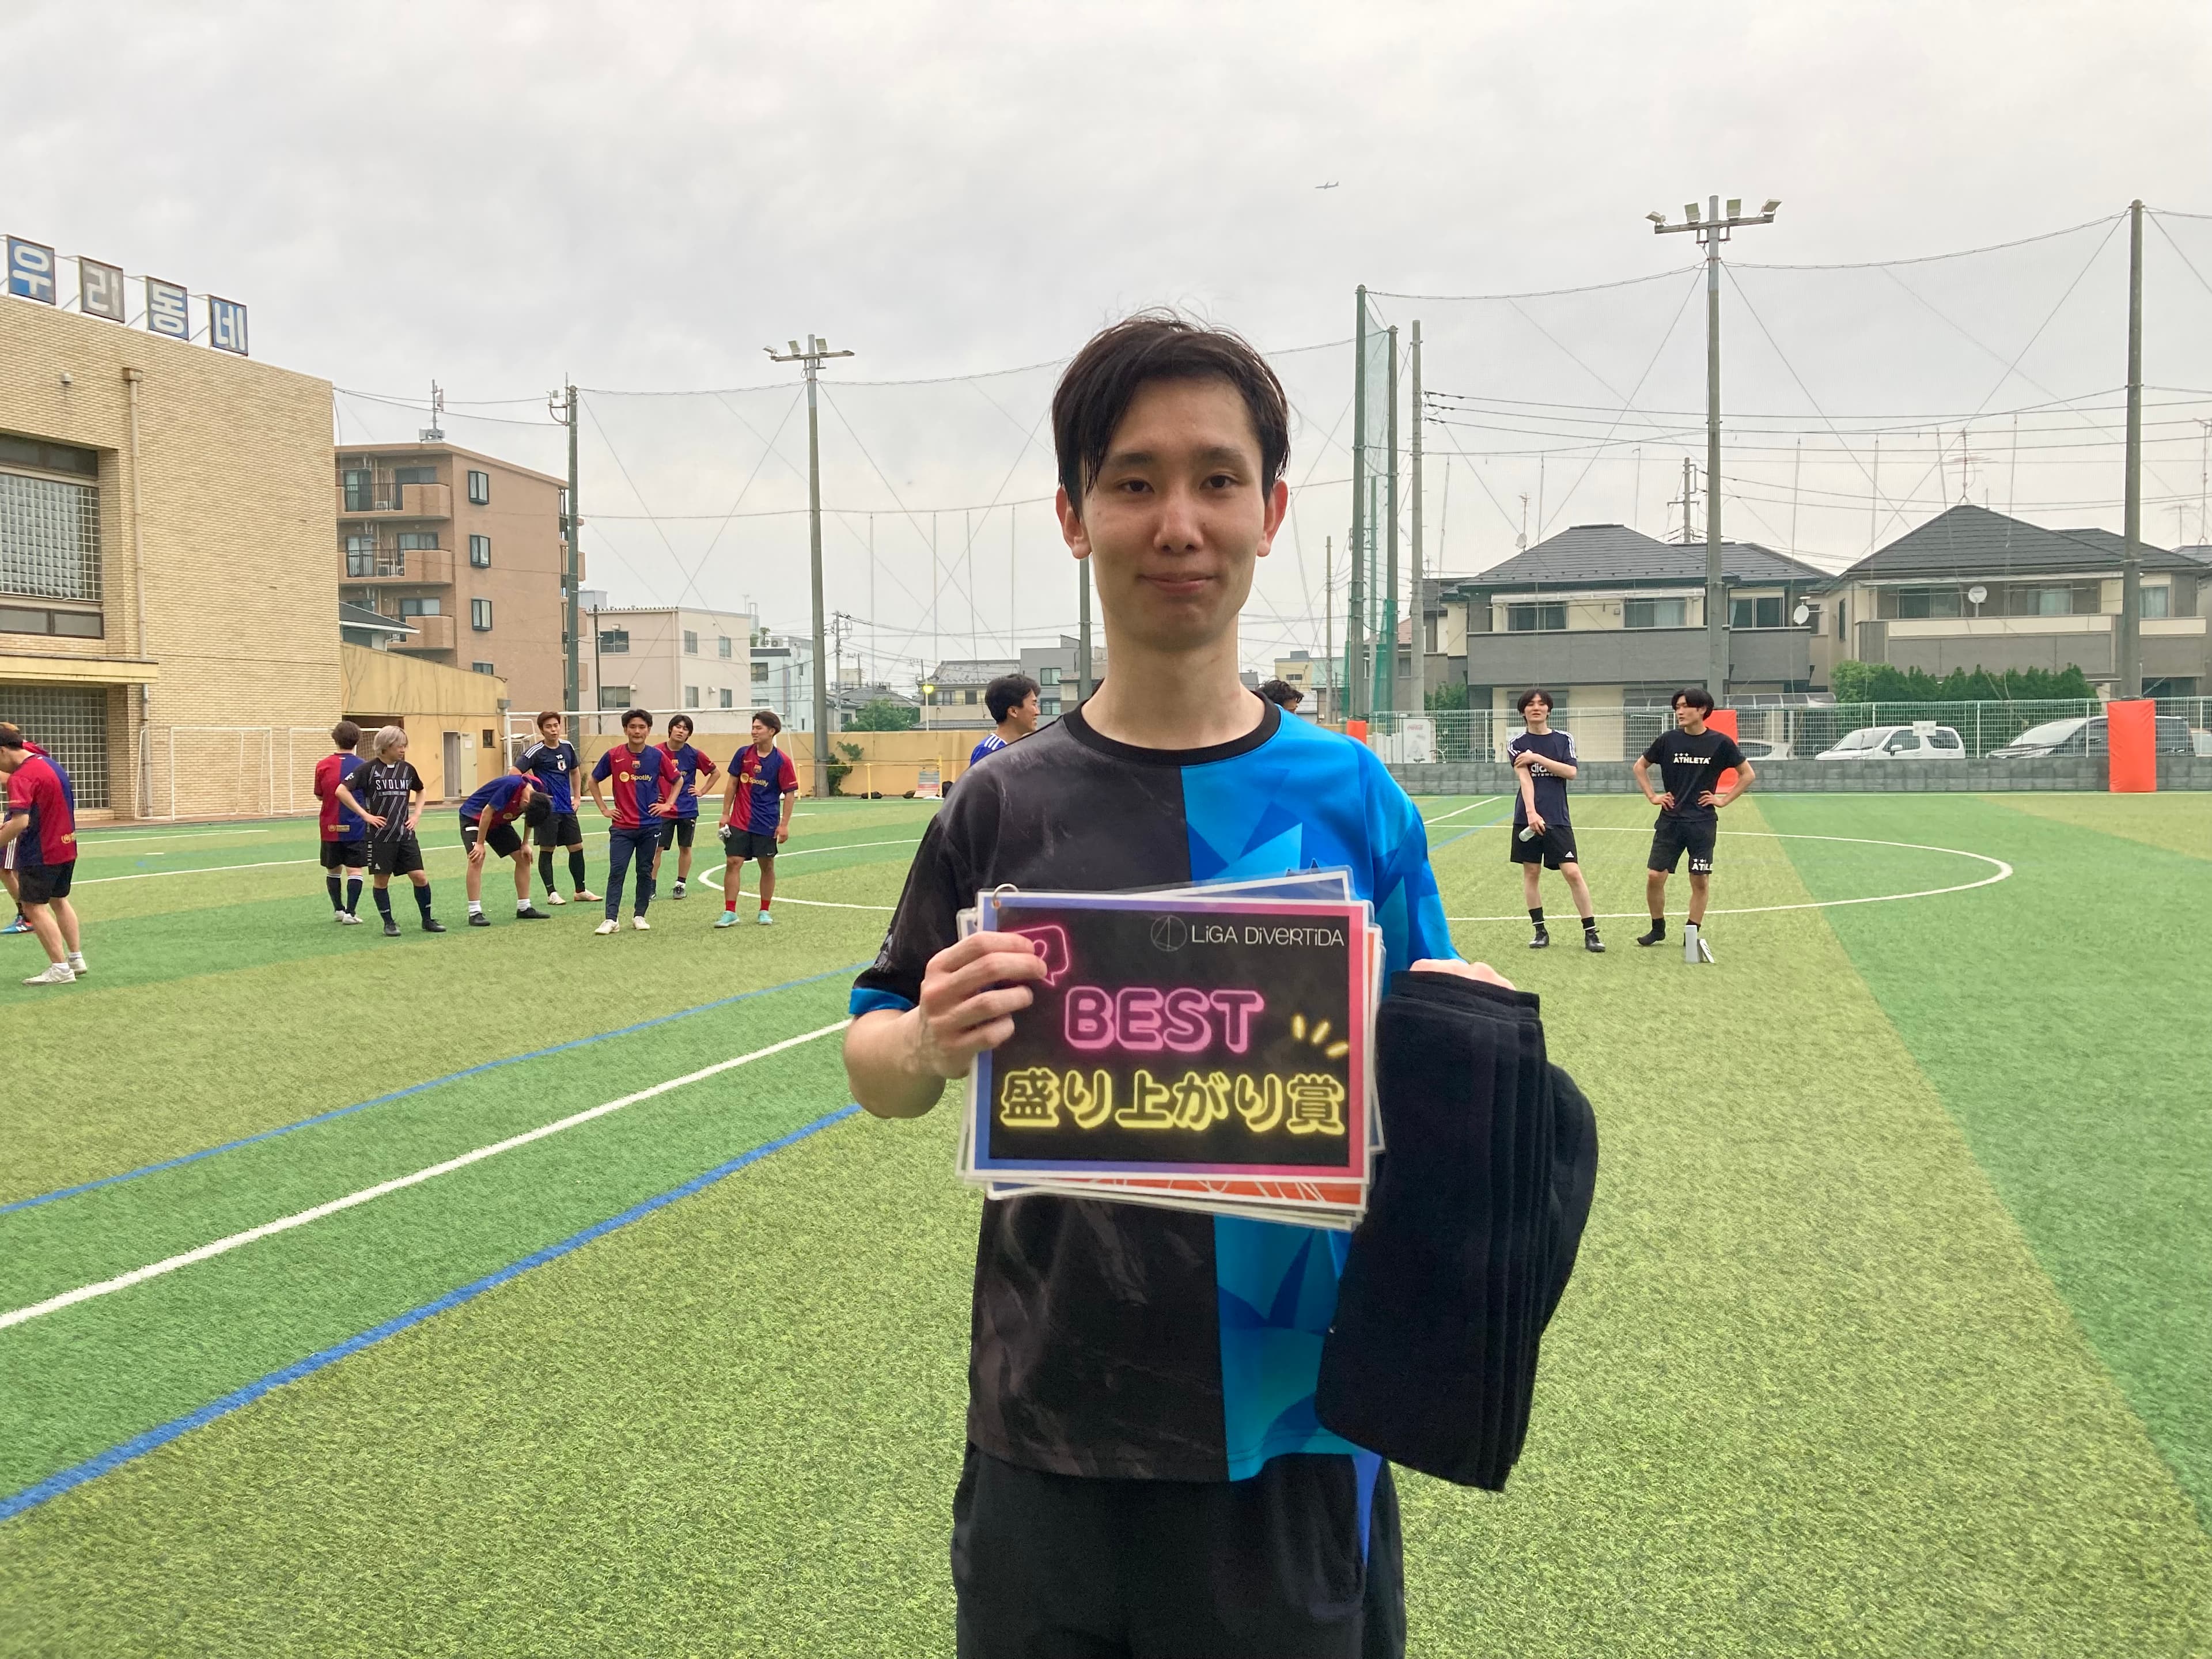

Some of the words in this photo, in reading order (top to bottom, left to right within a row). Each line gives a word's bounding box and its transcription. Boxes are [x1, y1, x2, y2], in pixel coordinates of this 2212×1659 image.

[12, 245, 246, 350] 우리동네
[749, 777, 768, 787] Spotify
[1673, 756, 1710, 764] ATHLETA
[1065, 986, 1264, 1053] BEST
[1000, 1066, 1345, 1135] 盛り上がり賞
